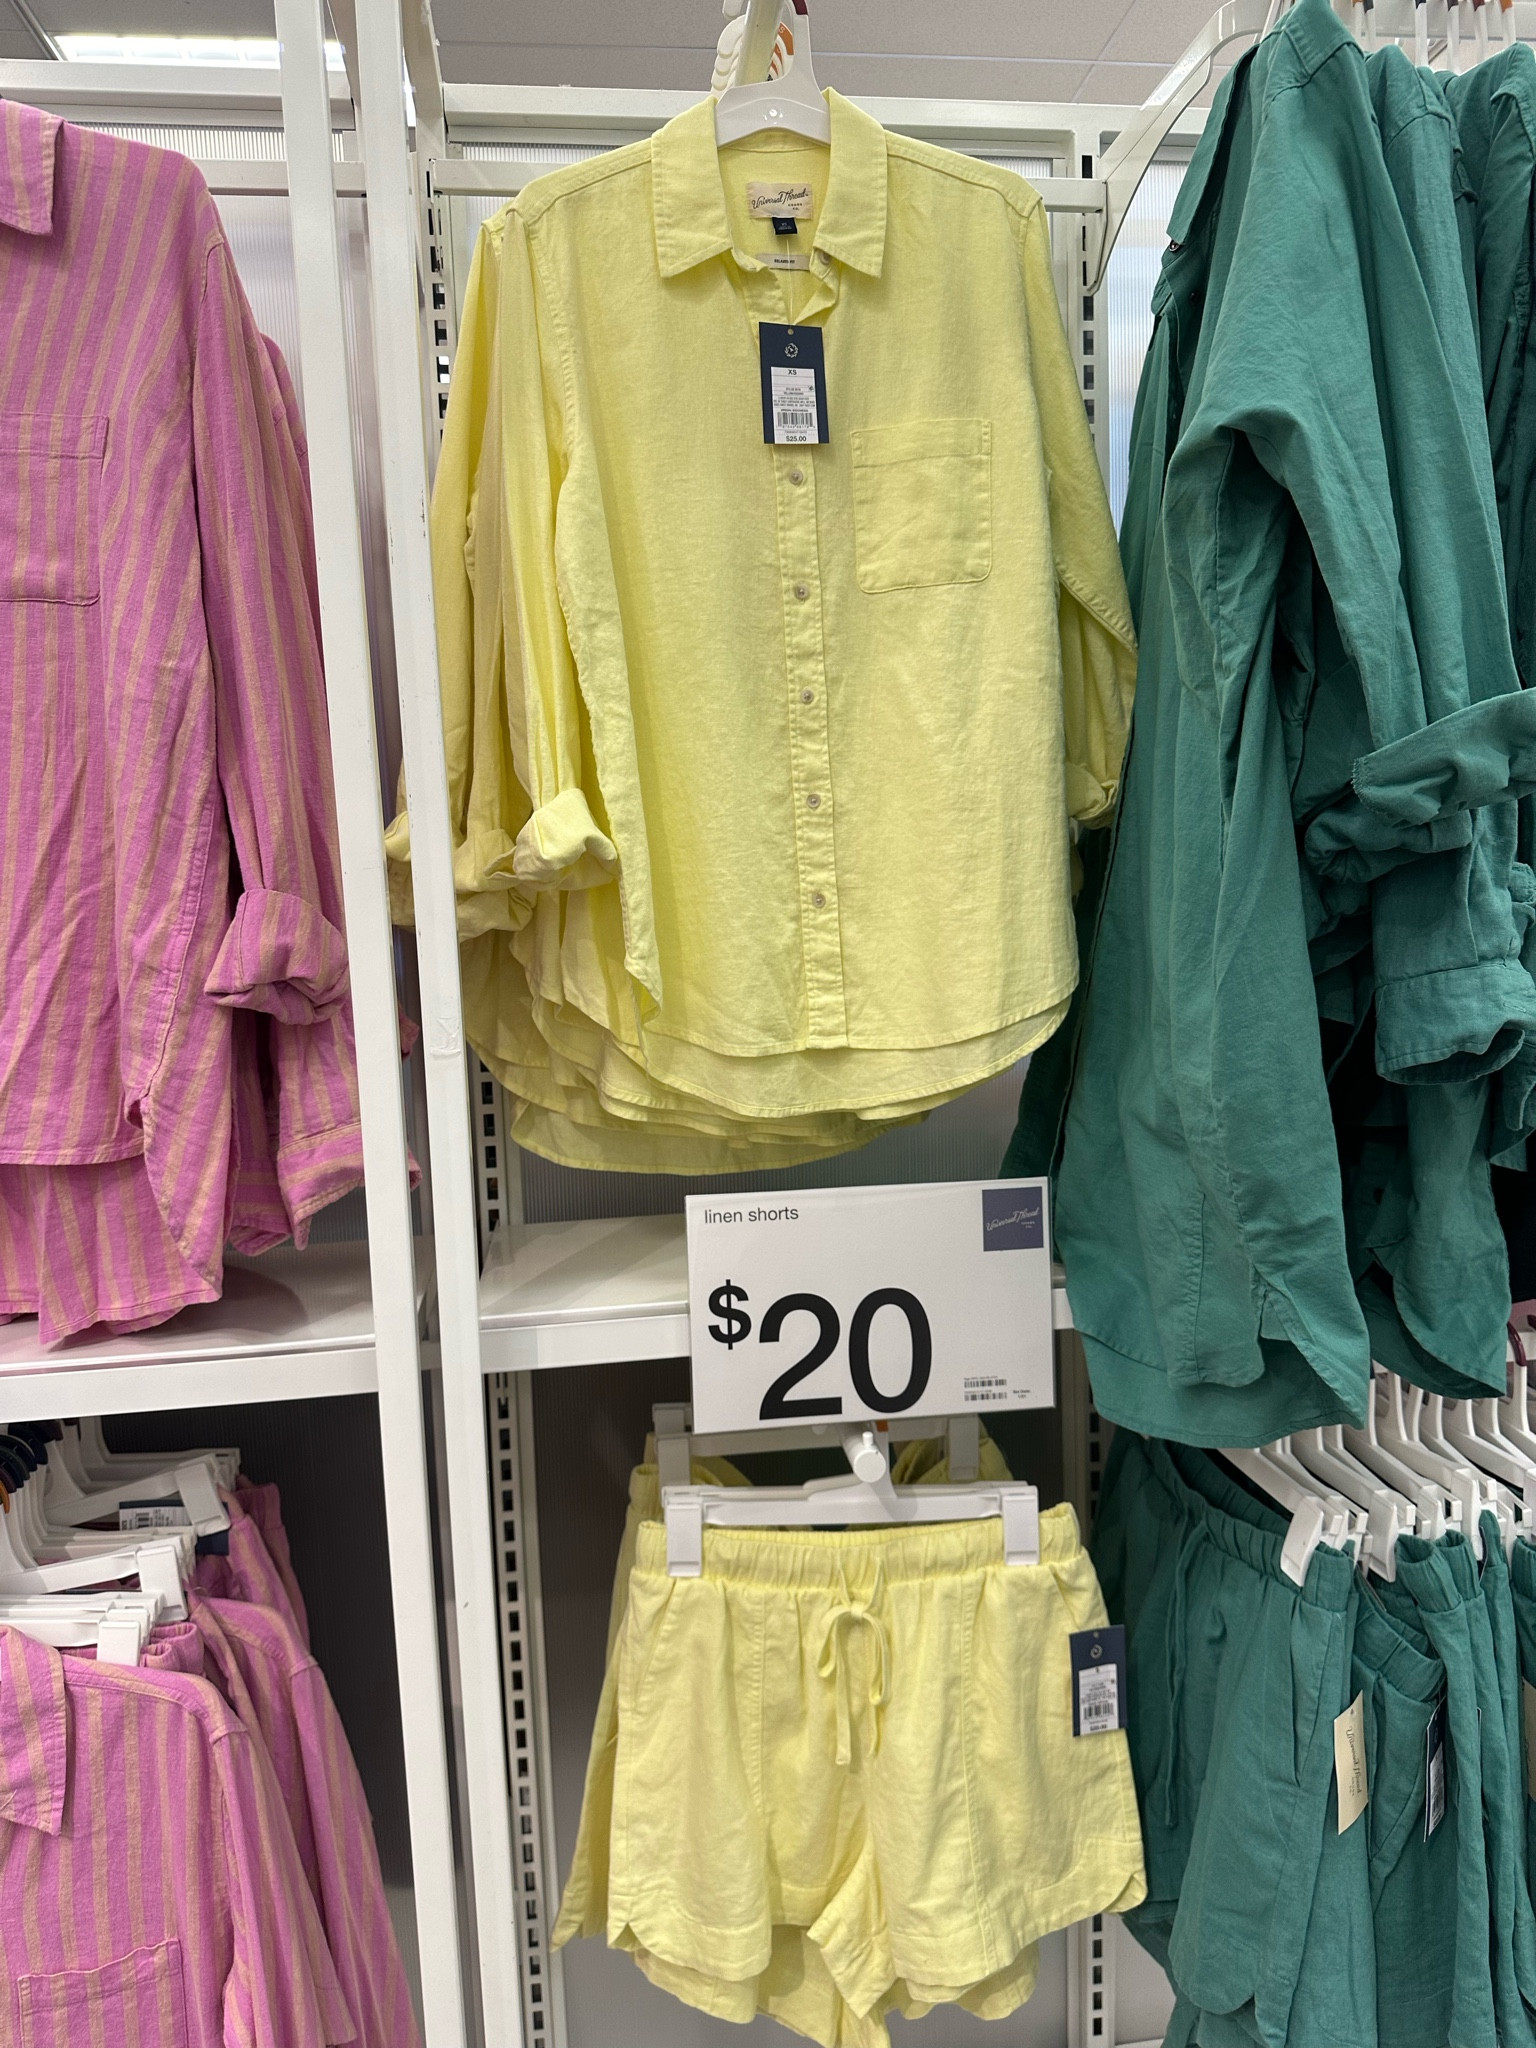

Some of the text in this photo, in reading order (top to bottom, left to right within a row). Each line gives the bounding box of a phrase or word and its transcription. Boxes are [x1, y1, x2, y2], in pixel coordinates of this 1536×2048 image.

[752, 188, 806, 209] Universal Thread
[704, 1206, 799, 1224] linen shorts
[708, 1279, 932, 1420] $20
